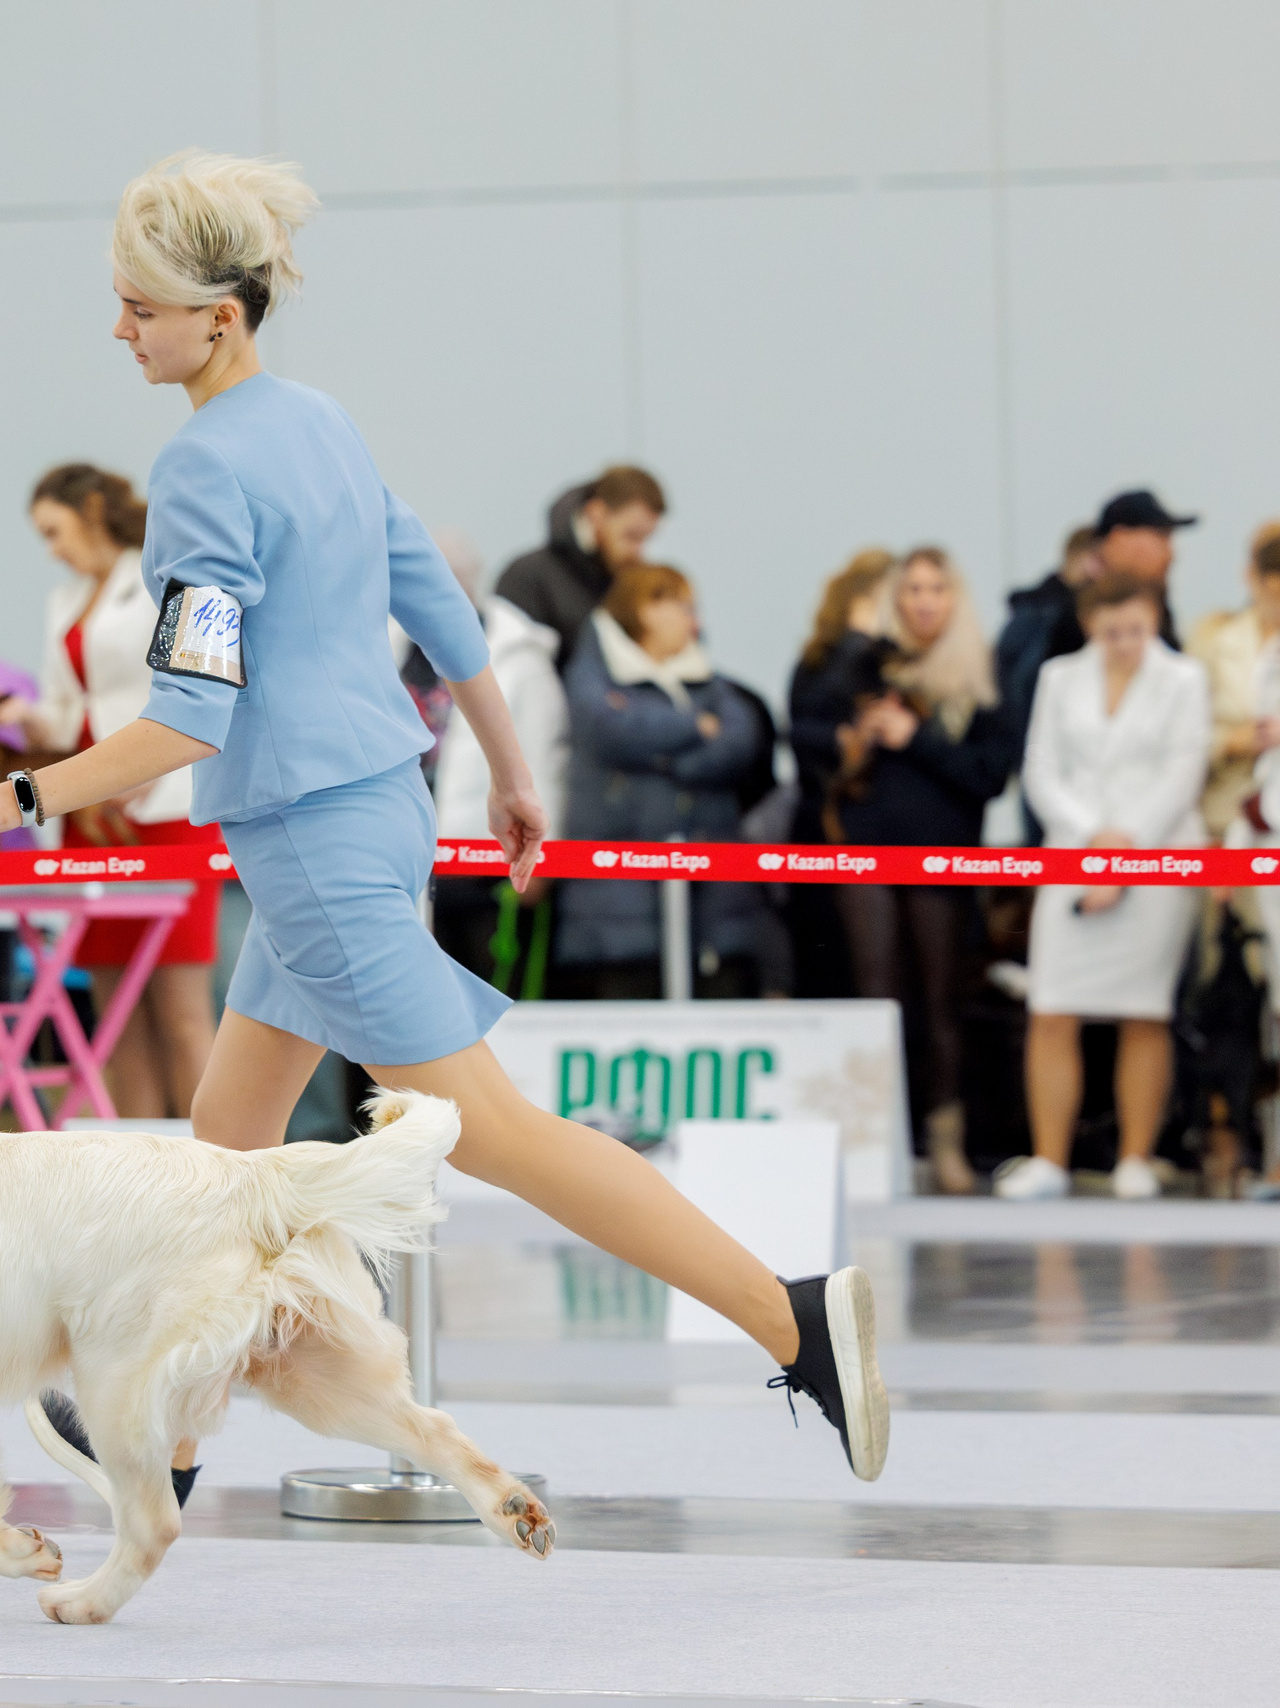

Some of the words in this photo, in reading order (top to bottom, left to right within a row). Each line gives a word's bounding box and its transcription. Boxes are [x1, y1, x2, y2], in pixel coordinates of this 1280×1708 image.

[458, 844, 504, 863] Kazan
[622, 851, 669, 868] Kazan
[670, 852, 710, 872] Expo
[61, 859, 106, 874] Kazan
[108, 857, 145, 876] Expo
[787, 854, 835, 870] Kazan
[837, 854, 876, 874] Expo
[952, 857, 1001, 873] Kazan
[1002, 857, 1043, 877] Expo
[1111, 857, 1160, 873] Kazan
[1162, 856, 1203, 876] Expo
